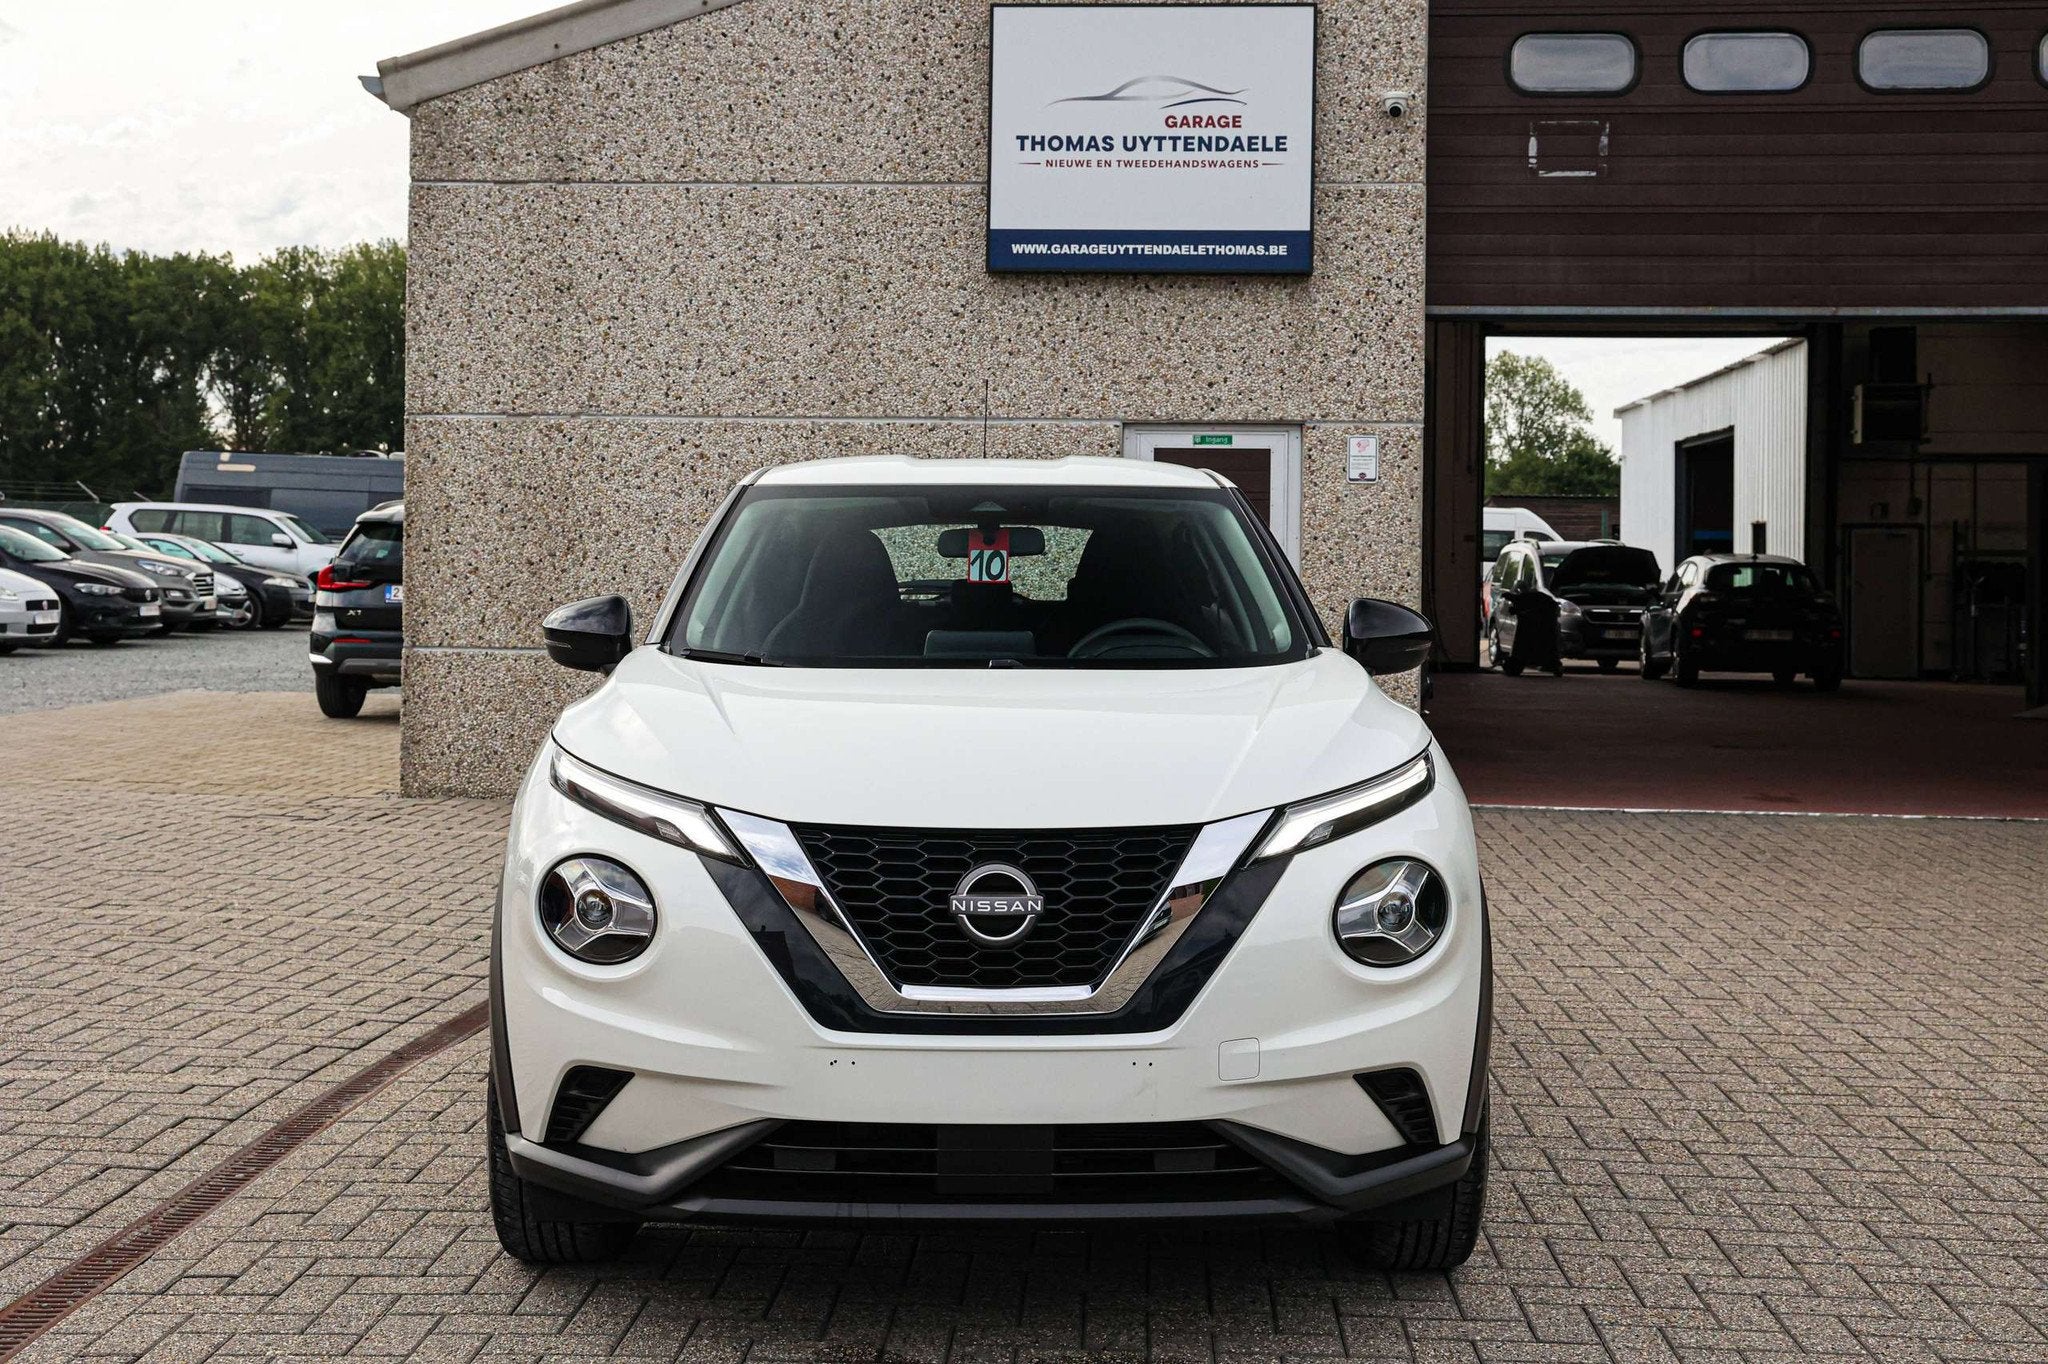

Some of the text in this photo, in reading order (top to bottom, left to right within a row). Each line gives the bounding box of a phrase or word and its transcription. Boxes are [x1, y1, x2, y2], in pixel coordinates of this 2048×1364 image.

[1164, 115, 1243, 129] GARAGE
[1015, 134, 1288, 152] THOMAS UYTTENDAELE
[1045, 159, 1260, 169] NIEUWE EN TWEEDEHANDSWAGENS
[1011, 243, 1288, 257] WWW.GARAGEUYTTENDAELETHOMAS.BE
[970, 550, 1005, 581] 10
[952, 900, 1042, 912] NISSAN
